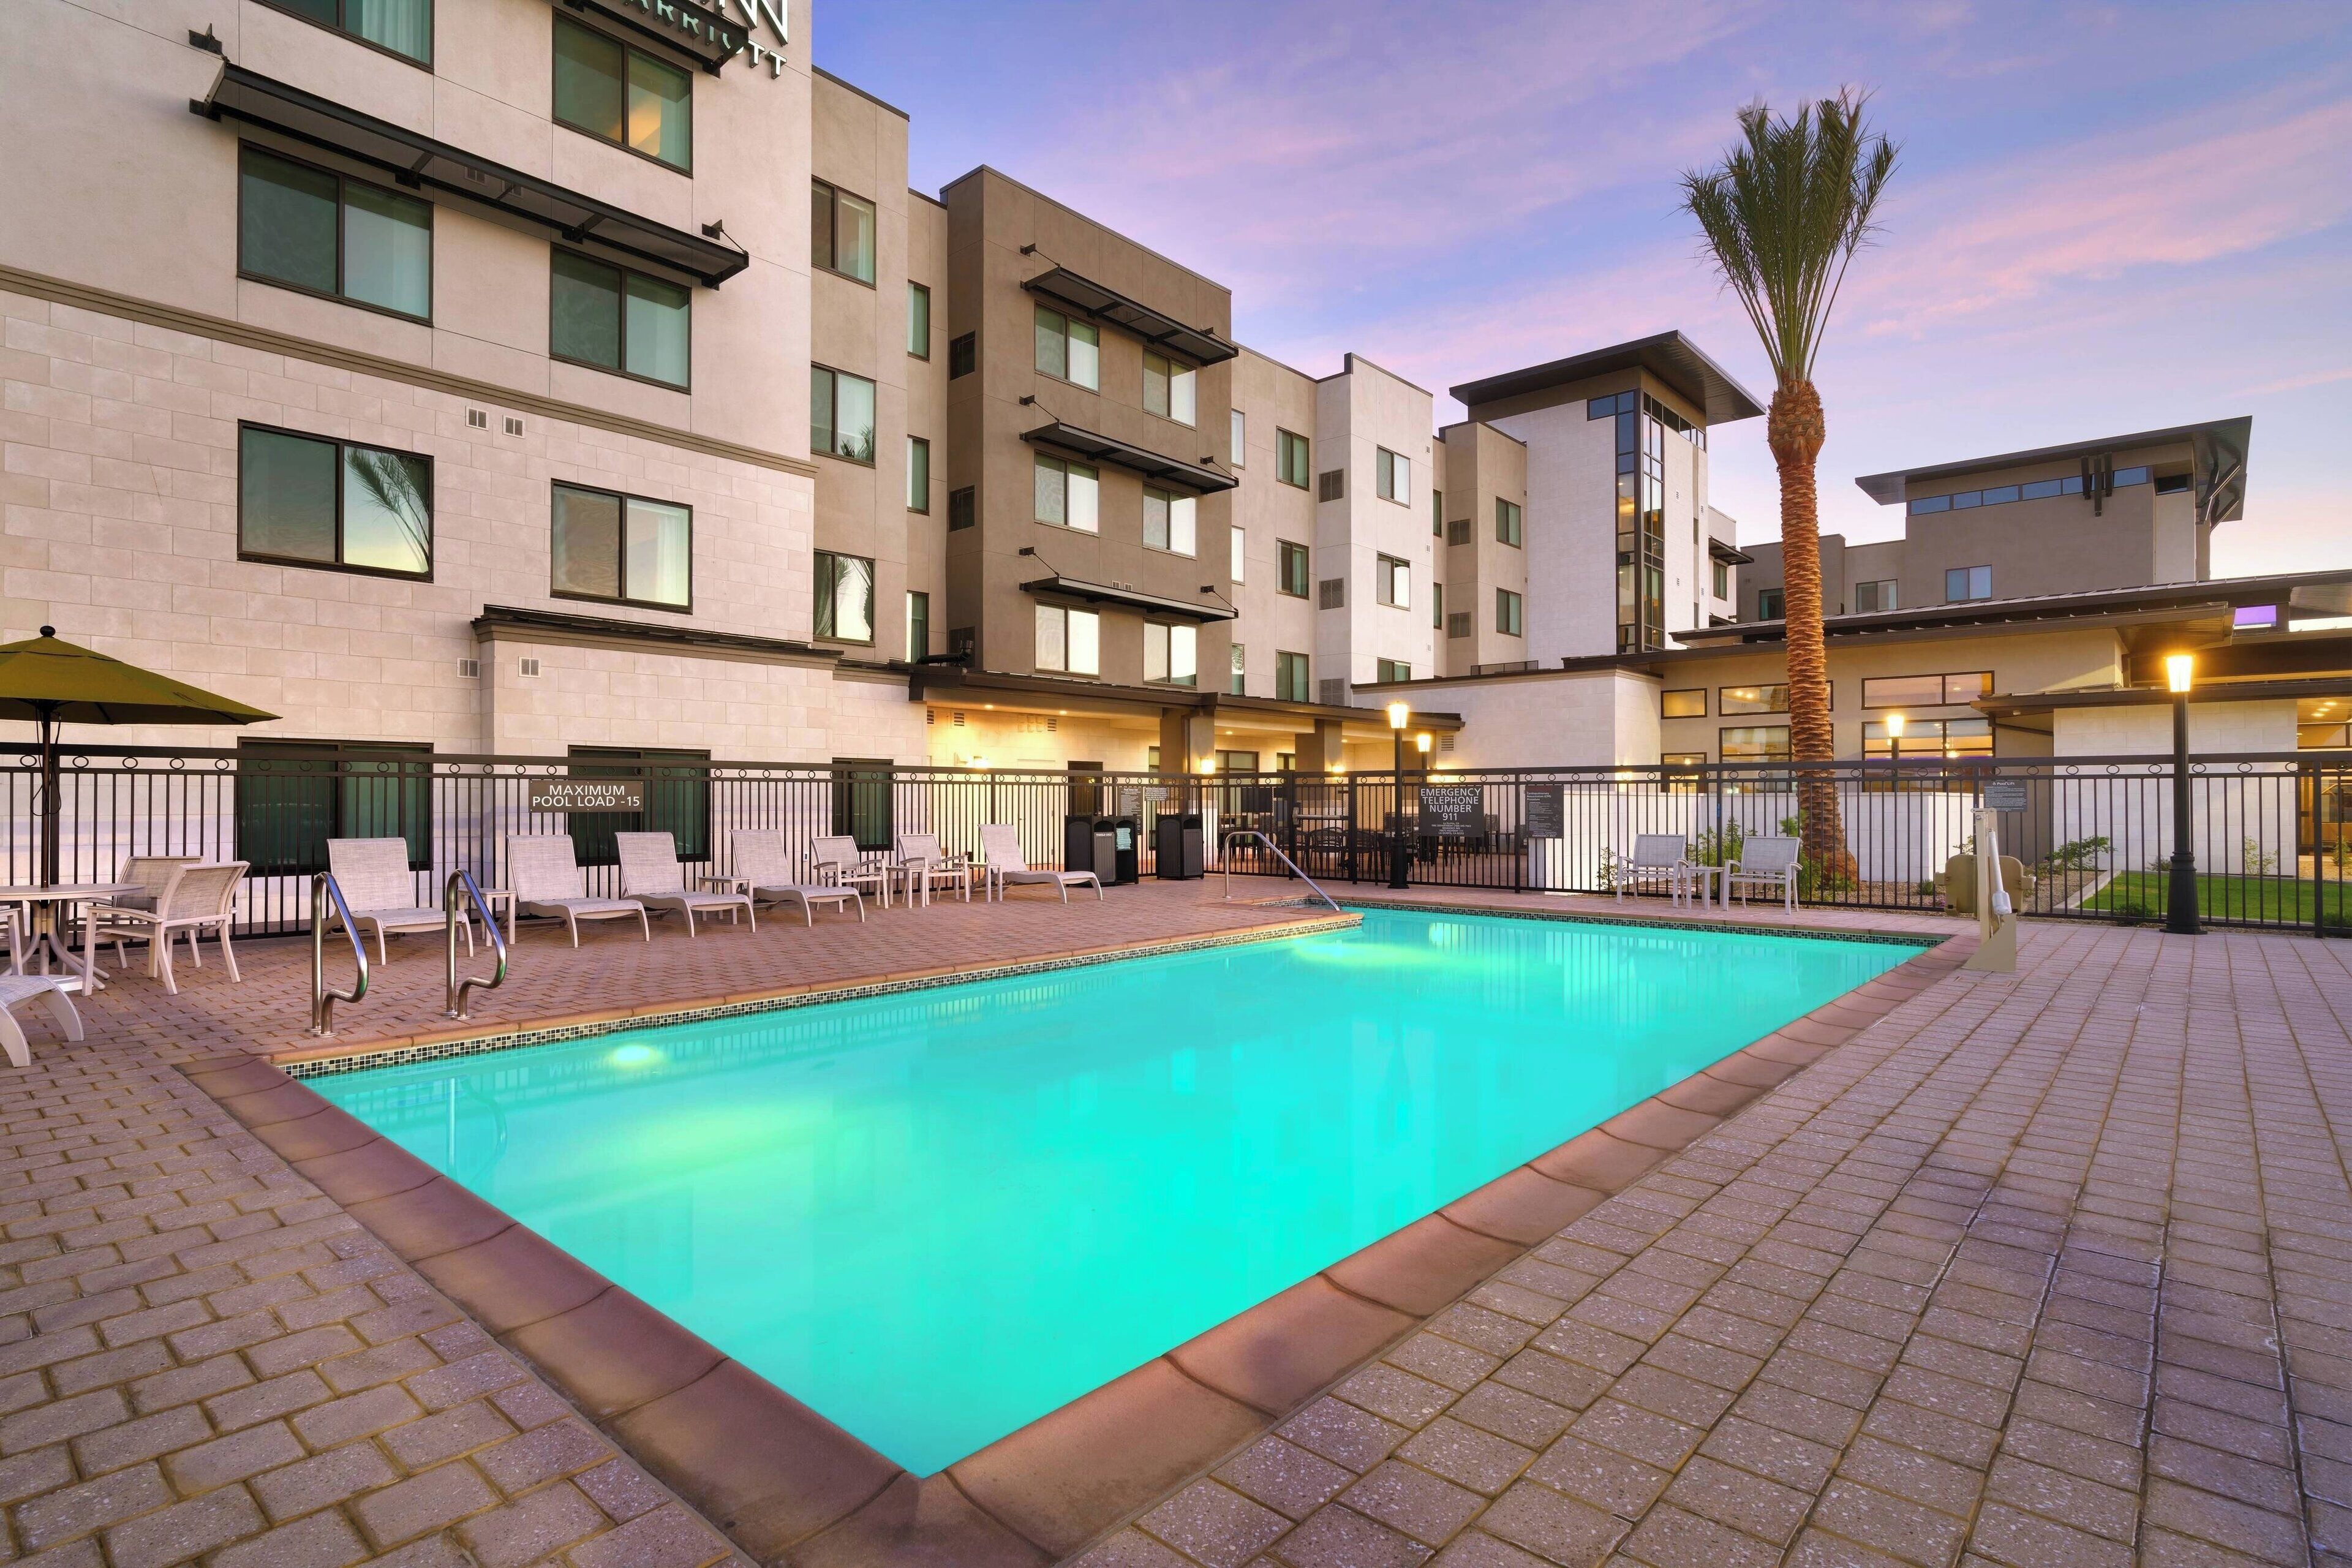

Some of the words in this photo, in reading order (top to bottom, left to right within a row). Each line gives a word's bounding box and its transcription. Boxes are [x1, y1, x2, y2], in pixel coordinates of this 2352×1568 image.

[549, 785, 625, 796] MAXIMUM
[532, 796, 572, 807] POOL
[578, 796, 616, 807] LOAD
[620, 796, 640, 807] -15
